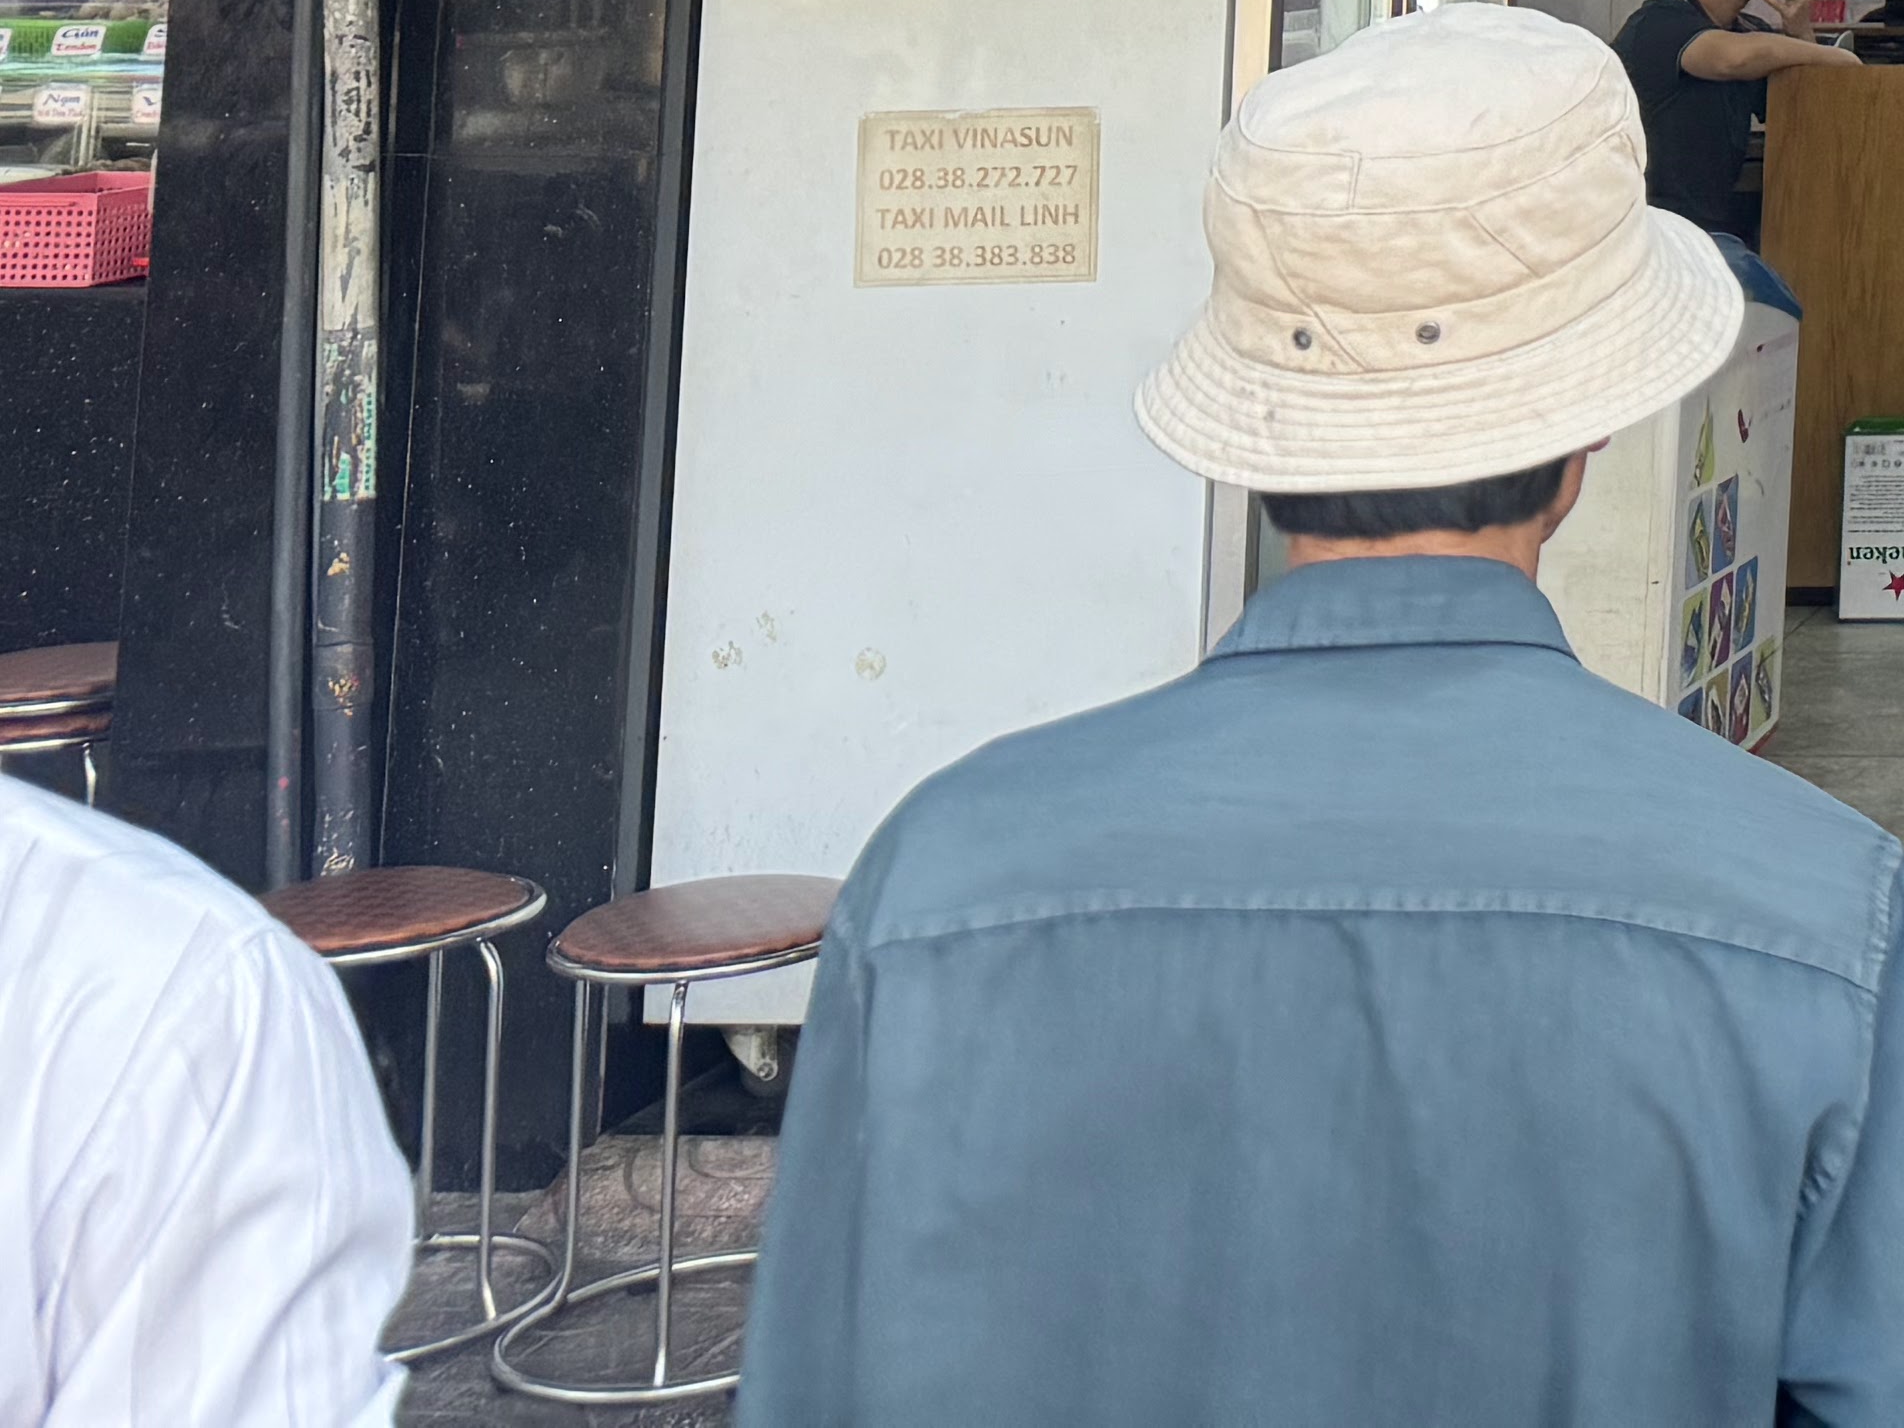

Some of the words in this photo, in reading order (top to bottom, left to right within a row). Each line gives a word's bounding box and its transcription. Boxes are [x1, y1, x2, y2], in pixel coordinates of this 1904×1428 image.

[885, 130, 944, 151] TAXI
[953, 125, 1074, 149] VINASUN
[879, 165, 1078, 190] 028.38.272.727
[876, 208, 934, 230] TAXI
[944, 206, 1011, 228] MAIL
[1020, 204, 1080, 226] LINH
[878, 247, 924, 269] 028
[932, 244, 1076, 268] 38.383.838
